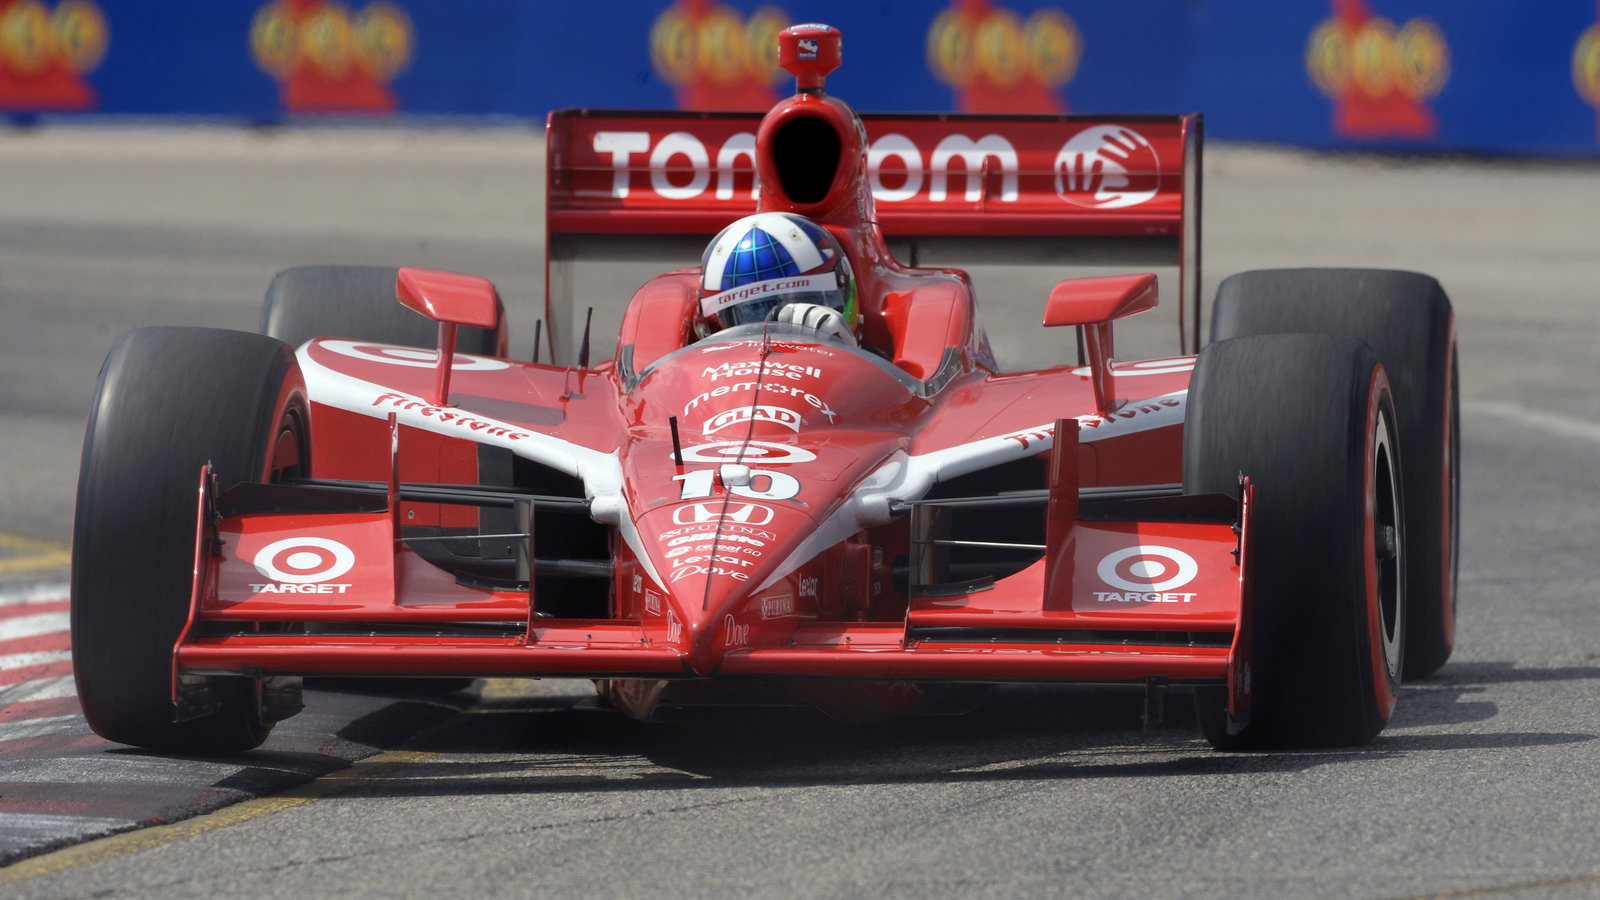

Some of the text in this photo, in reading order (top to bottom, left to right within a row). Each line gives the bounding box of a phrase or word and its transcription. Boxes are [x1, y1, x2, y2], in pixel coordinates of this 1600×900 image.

[593, 131, 1018, 201] Toom
[718, 278, 810, 305] target.com
[701, 360, 822, 379] Maxwell
[711, 368, 802, 381] House
[684, 381, 835, 425] memorex
[372, 392, 530, 440] Firestone
[712, 407, 796, 427] GLAD
[1004, 398, 1180, 451] Firstone
[671, 469, 801, 500] 10
[667, 532, 765, 547] Gillette
[685, 525, 770, 539] PURINA
[672, 555, 754, 568] Lexar
[743, 548, 762, 557] 60
[670, 565, 749, 583] Dove
[248, 583, 353, 594] TARGET
[799, 572, 818, 597] Lexar
[1093, 592, 1197, 603] TARGET
[724, 613, 750, 646] Dove
